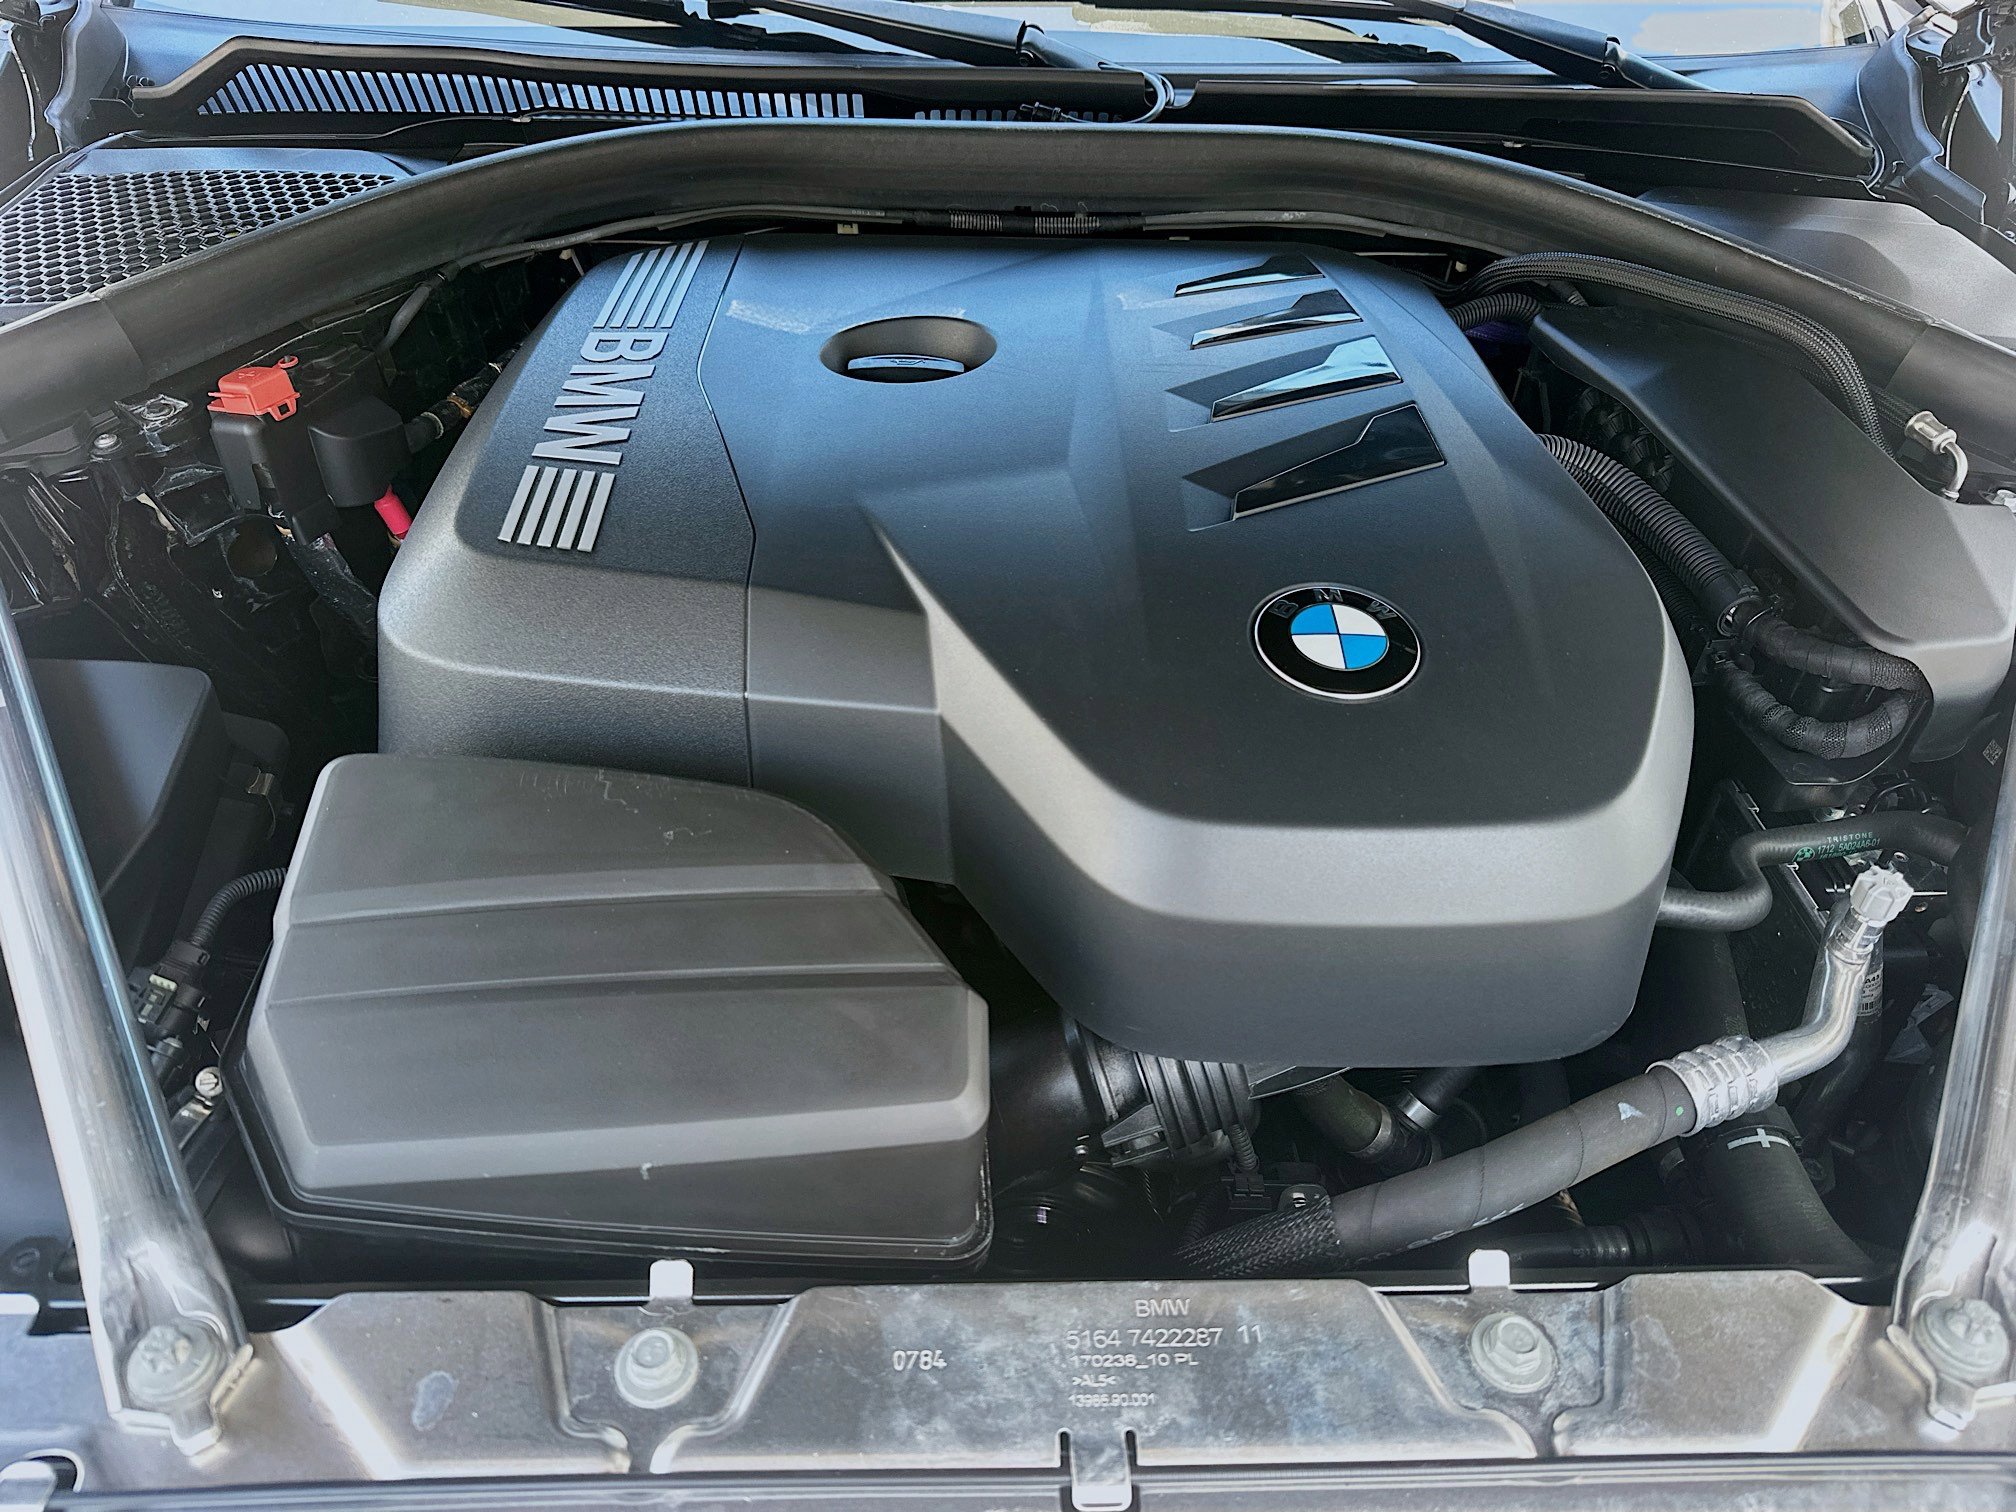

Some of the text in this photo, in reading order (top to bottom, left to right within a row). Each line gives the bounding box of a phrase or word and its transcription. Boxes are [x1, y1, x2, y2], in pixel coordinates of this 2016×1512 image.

[531, 332, 669, 466] BMW
[1268, 587, 1397, 620] BMW
[1827, 832, 1873, 843] TRISTONE
[1818, 844, 1835, 854] 1712
[1135, 1299, 1191, 1317] BMW
[1065, 1325, 1264, 1349] 5164 7422287 11
[893, 1349, 948, 1371] 0784
[1174, 1353, 1199, 1366] PL
